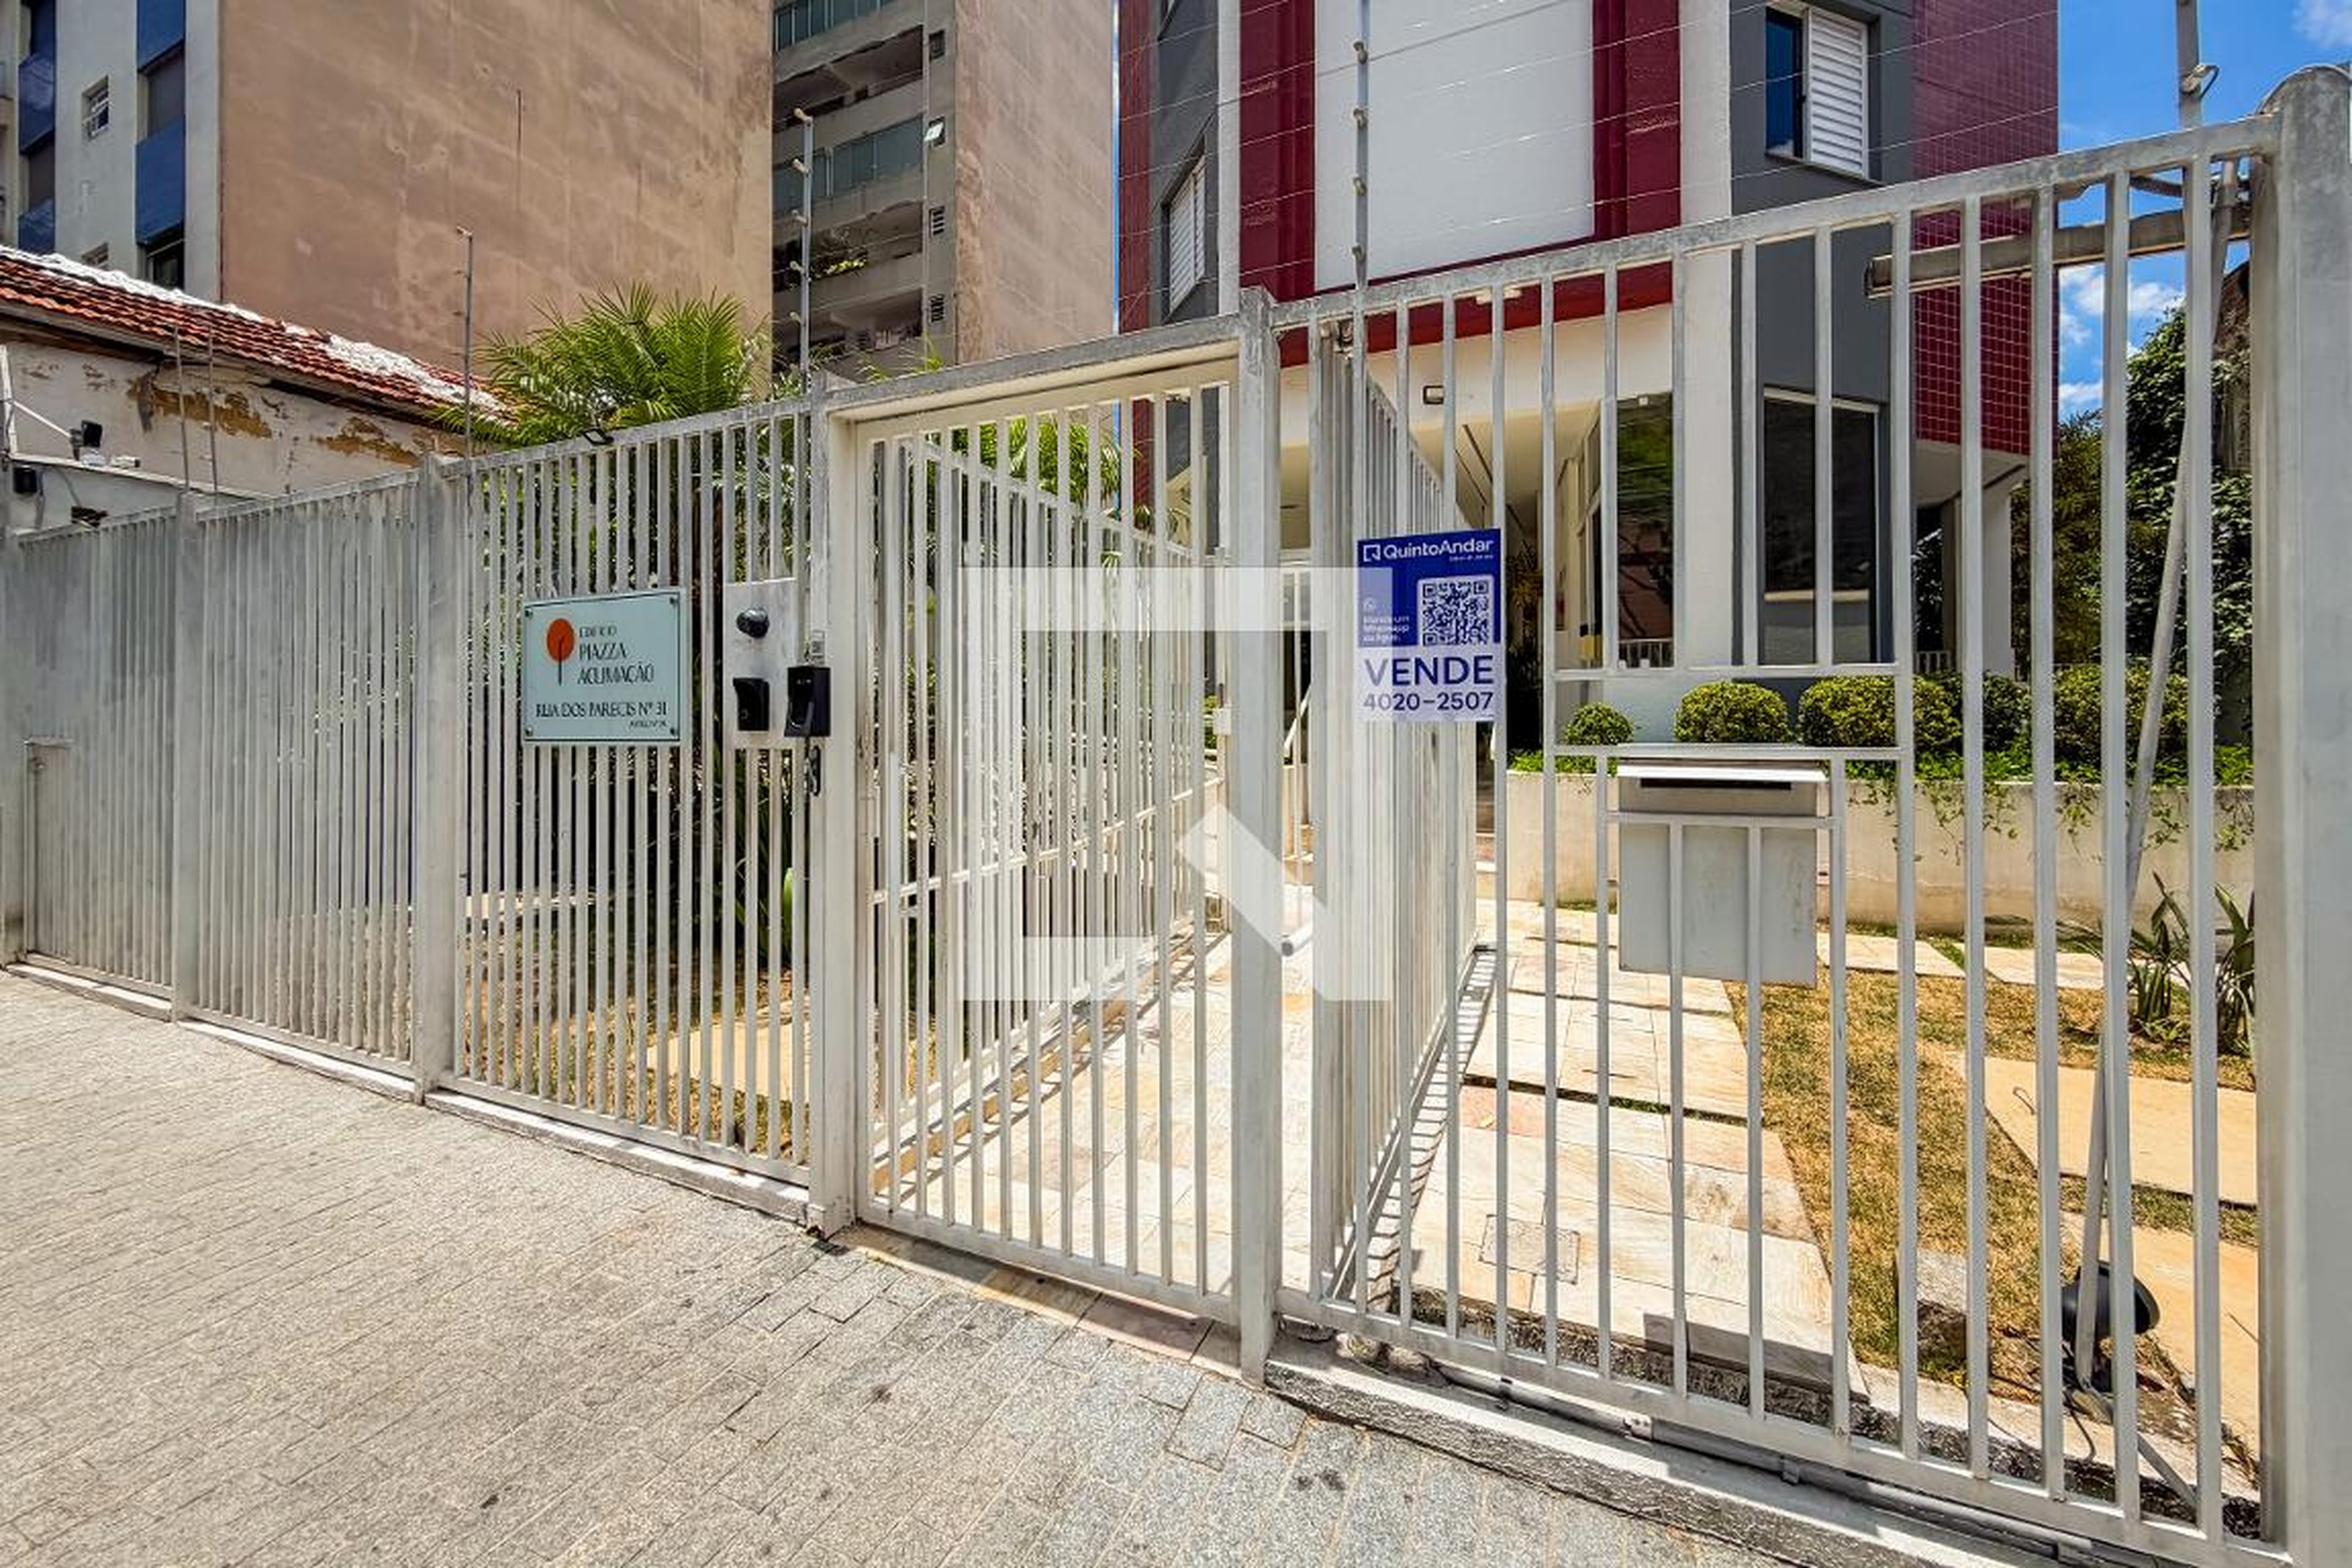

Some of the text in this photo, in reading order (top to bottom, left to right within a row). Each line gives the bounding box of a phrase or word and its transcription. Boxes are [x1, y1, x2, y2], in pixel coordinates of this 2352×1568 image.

[1383, 538, 1494, 559] QuintoAndar
[579, 642, 627, 661] PIAZZA
[1364, 655, 1494, 687] VENDE
[562, 703, 586, 717] DOS
[656, 701, 667, 715] 31
[1363, 692, 1494, 712] 4020-2507
